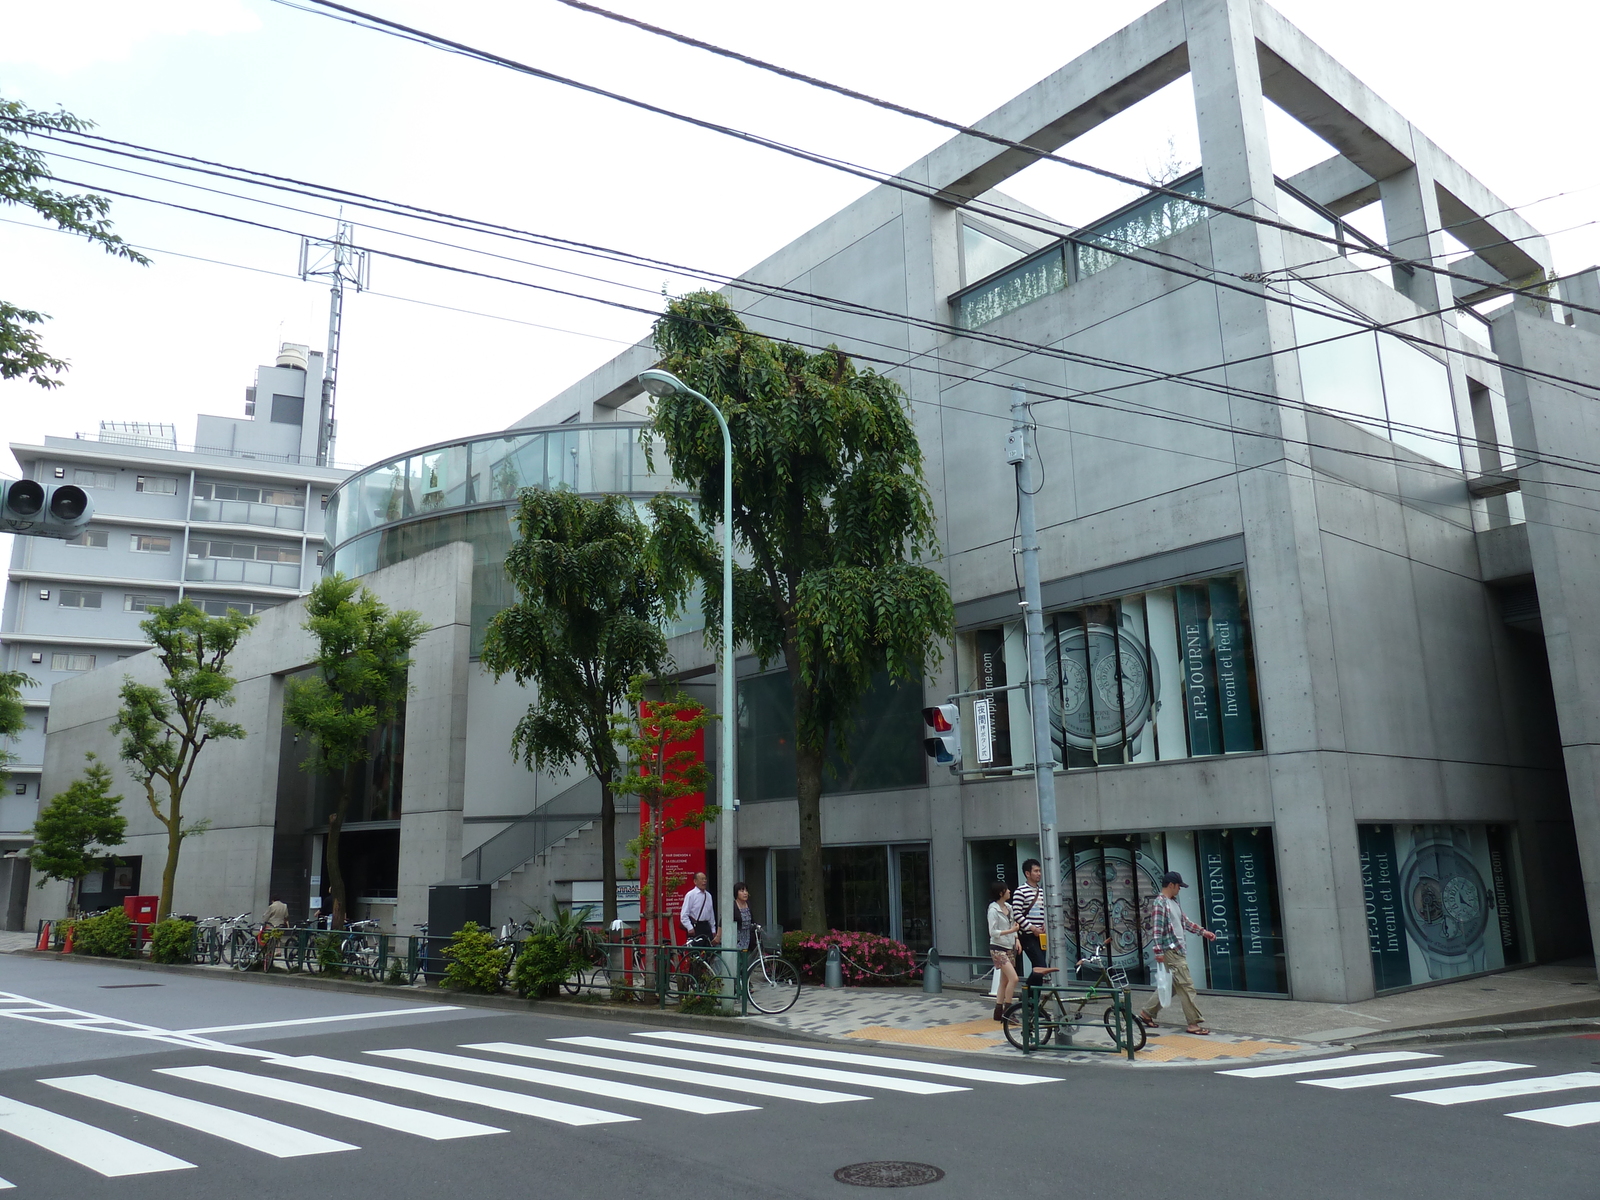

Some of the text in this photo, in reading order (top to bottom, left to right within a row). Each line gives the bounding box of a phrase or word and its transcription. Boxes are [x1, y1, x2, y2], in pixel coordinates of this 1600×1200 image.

[1186, 624, 1208, 720] F.P.JOURNE
[1216, 621, 1238, 717] Invenit et Fecit
[1207, 853, 1231, 956] F.P.JOURNE
[1240, 853, 1263, 954] Invenit et Fecit
[1375, 852, 1399, 952] Invenit et Fecit
[1491, 850, 1512, 947] www.fpjourne.com
